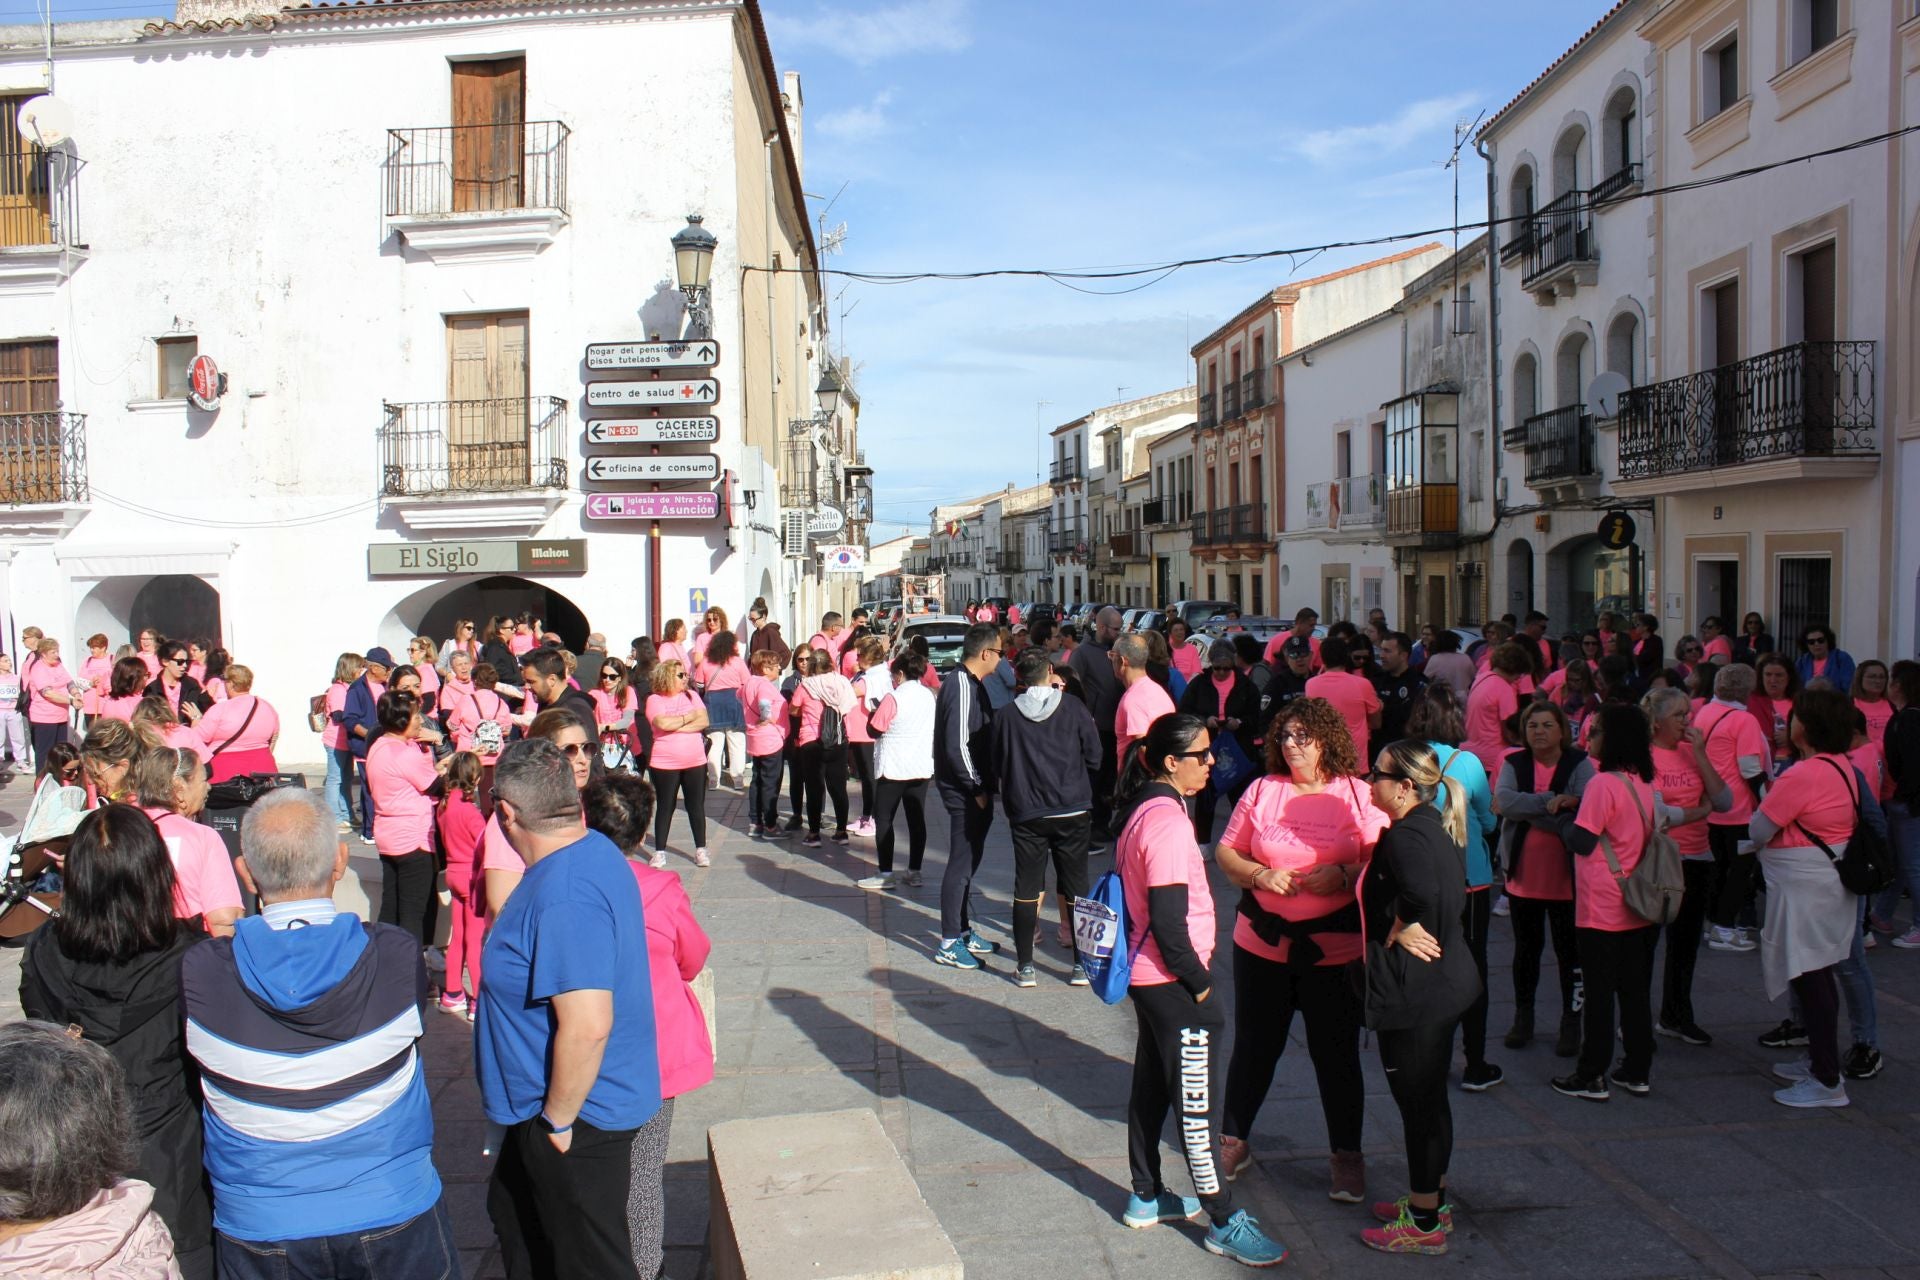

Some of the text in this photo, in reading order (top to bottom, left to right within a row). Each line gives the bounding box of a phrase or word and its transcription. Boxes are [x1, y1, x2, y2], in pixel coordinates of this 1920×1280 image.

[590, 344, 691, 357] hogar del pensionista
[590, 355, 661, 366] pisos tutelados
[590, 388, 675, 398] centro de salud
[608, 418, 713, 435] N-630 CÁCERES
[659, 430, 714, 439] PLASENCIA
[609, 463, 714, 472] oficina de consumo
[640, 505, 653, 515] La
[661, 504, 715, 515] Asunción
[531, 547, 569, 558] Mahou
[399, 546, 479, 572] El Siglo
[1077, 917, 1106, 942] 218
[1180, 1045, 1209, 1113] UNDER
[1183, 1116, 1220, 1195] ARMOUR
